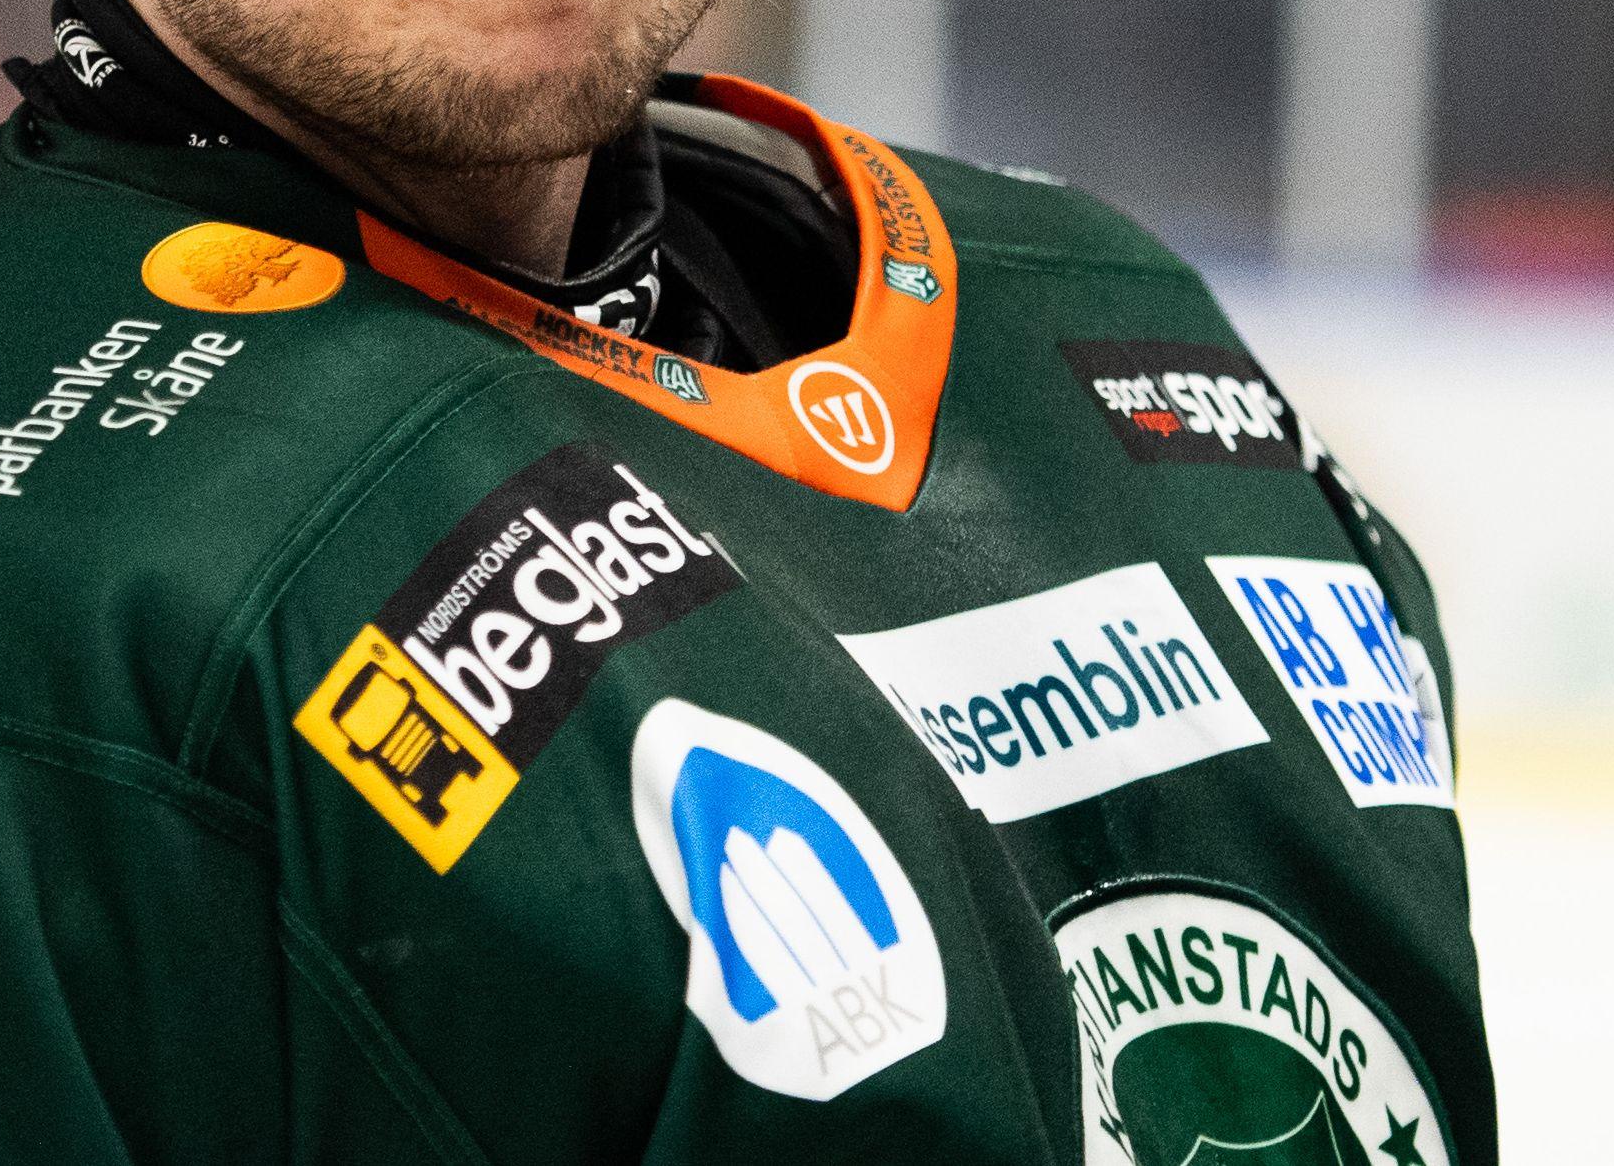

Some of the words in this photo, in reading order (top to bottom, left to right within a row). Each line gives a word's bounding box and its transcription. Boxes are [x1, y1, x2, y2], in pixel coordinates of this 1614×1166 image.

[99, 332, 245, 437] Skåne
[534, 307, 644, 367] HOCKEY
[416, 520, 534, 645] NORDSTRÖMS
[1235, 577, 1349, 689] AB
[889, 619, 1222, 776] ssemblin
[805, 963, 926, 1076] ABK
